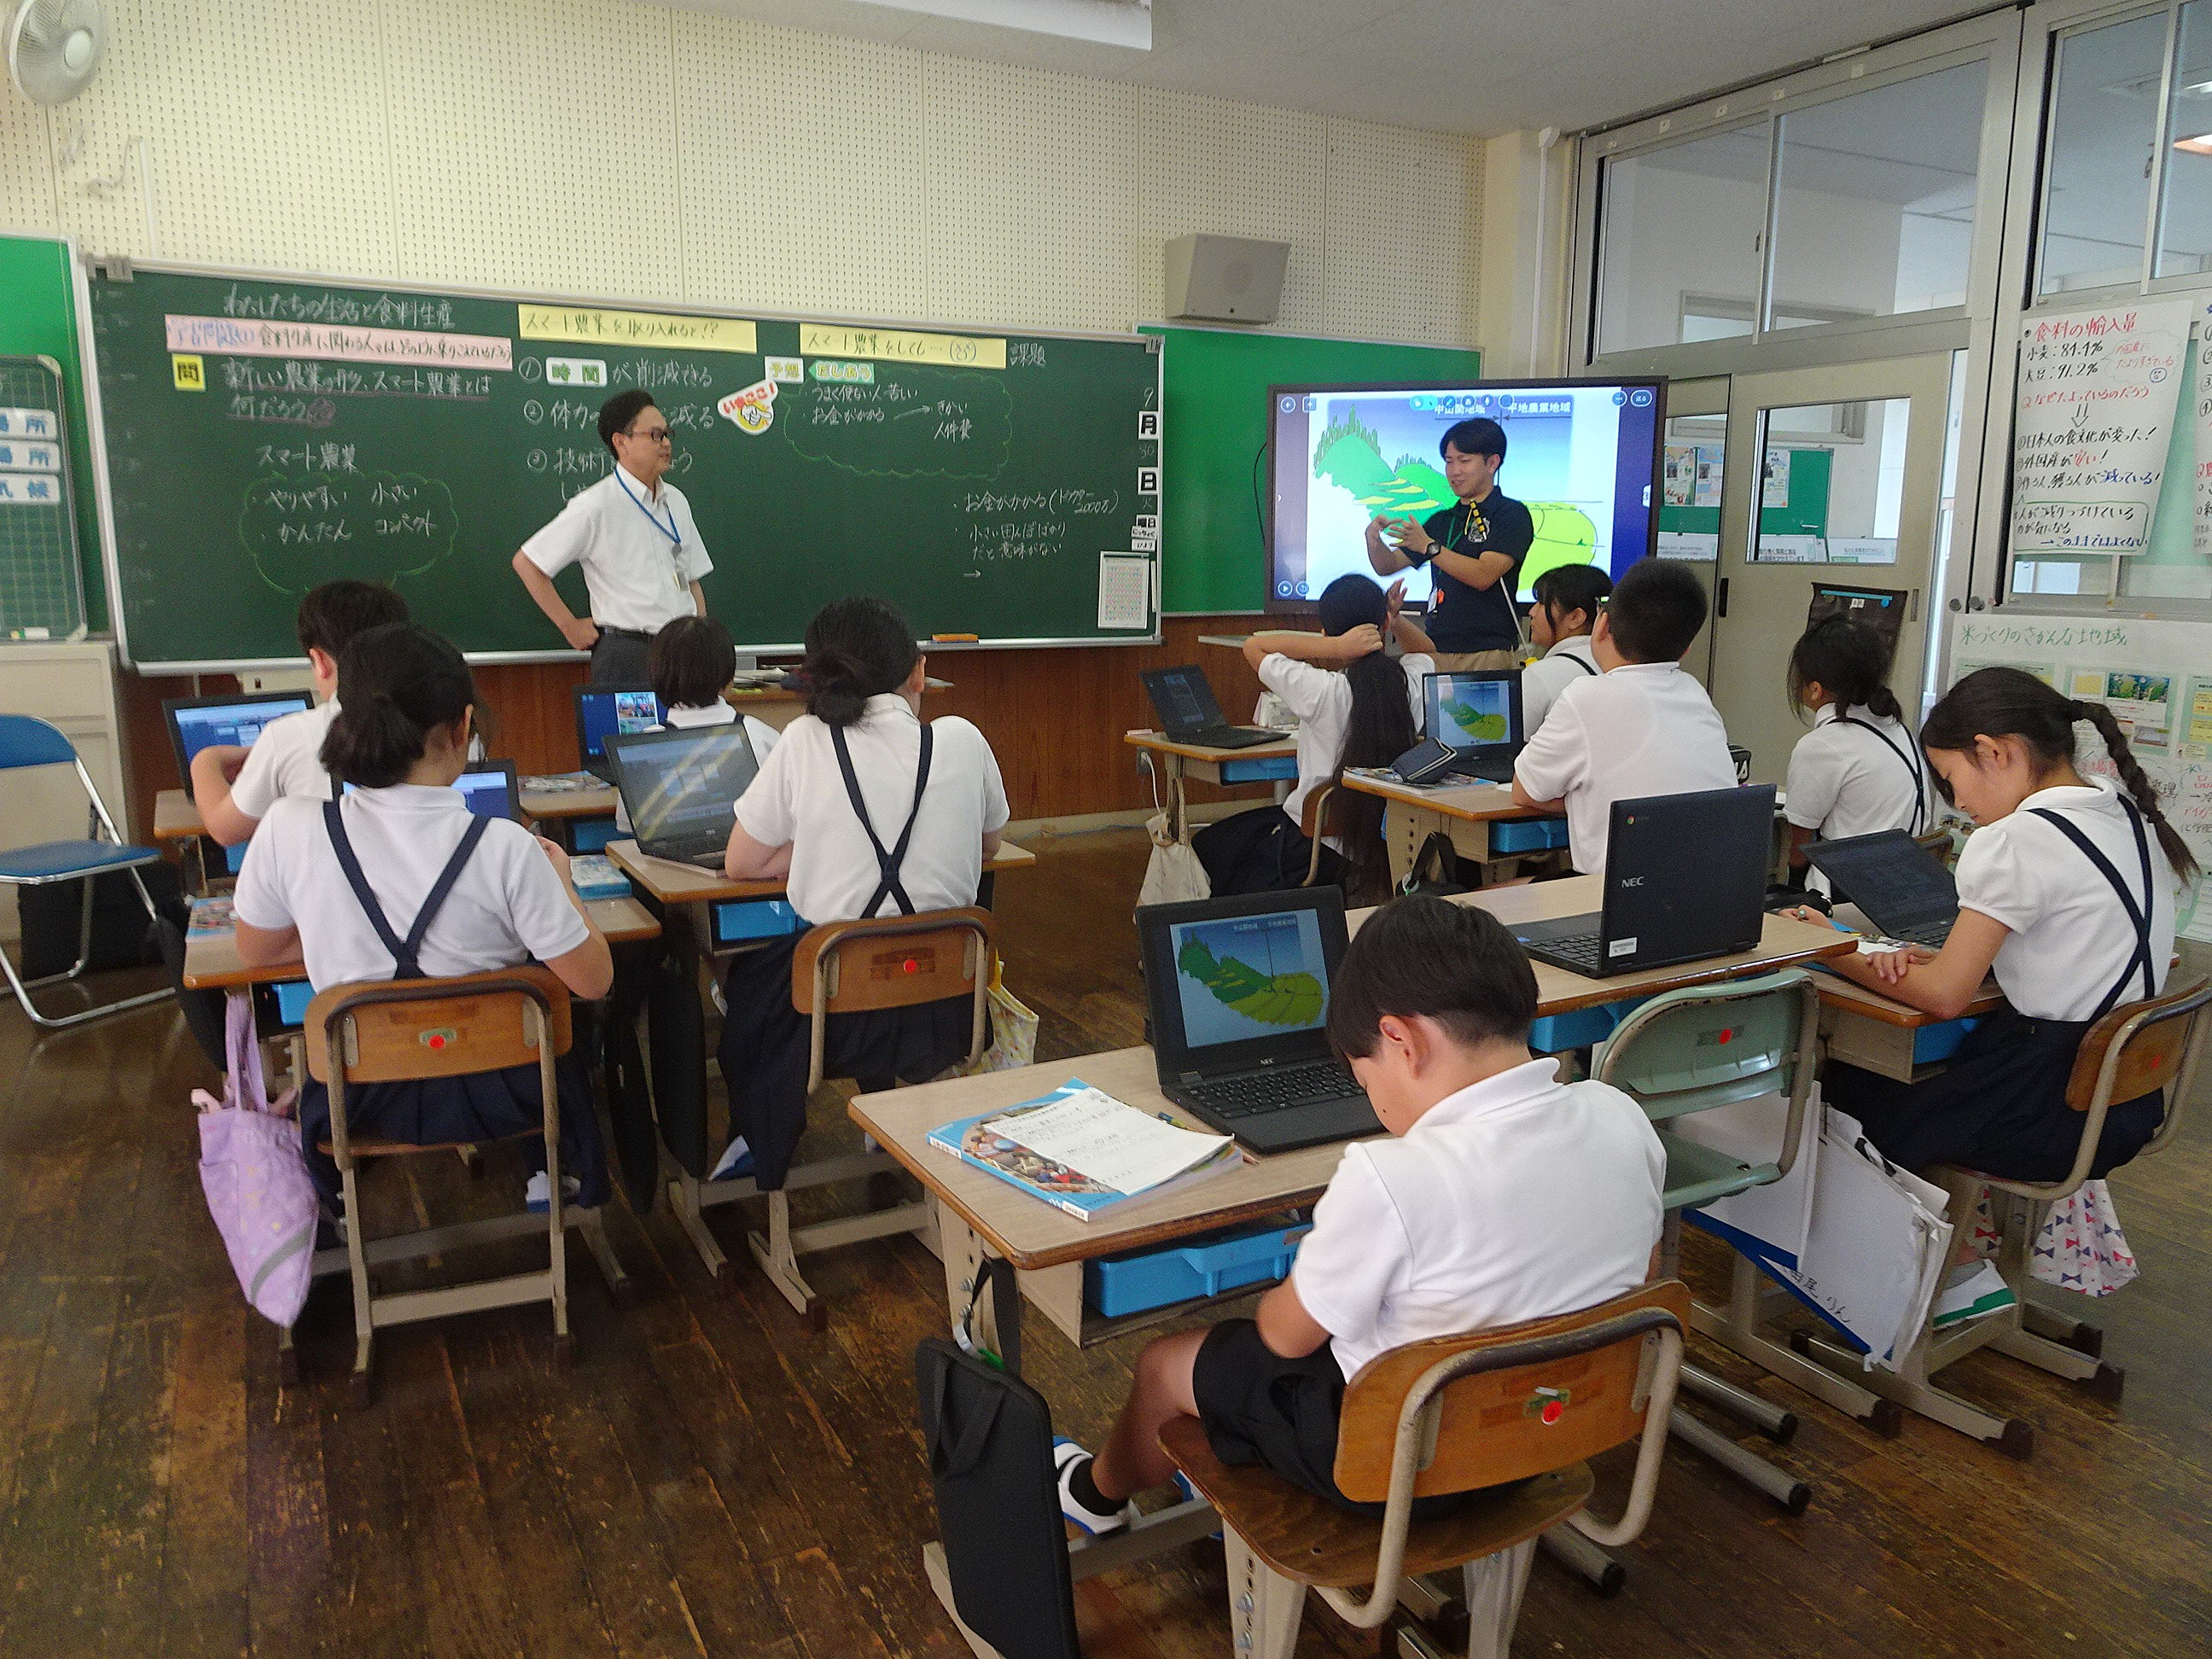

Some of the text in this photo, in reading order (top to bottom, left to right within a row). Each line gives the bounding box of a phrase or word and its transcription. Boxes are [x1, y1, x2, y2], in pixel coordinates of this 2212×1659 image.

[178, 360, 199, 381] 問
[817, 364, 871, 380] だしあう
[1140, 414, 1156, 434] 月
[1140, 472, 1156, 492] 日
[1621, 876, 1644, 888] NEC
[1260, 1057, 1274, 1066] NEC
